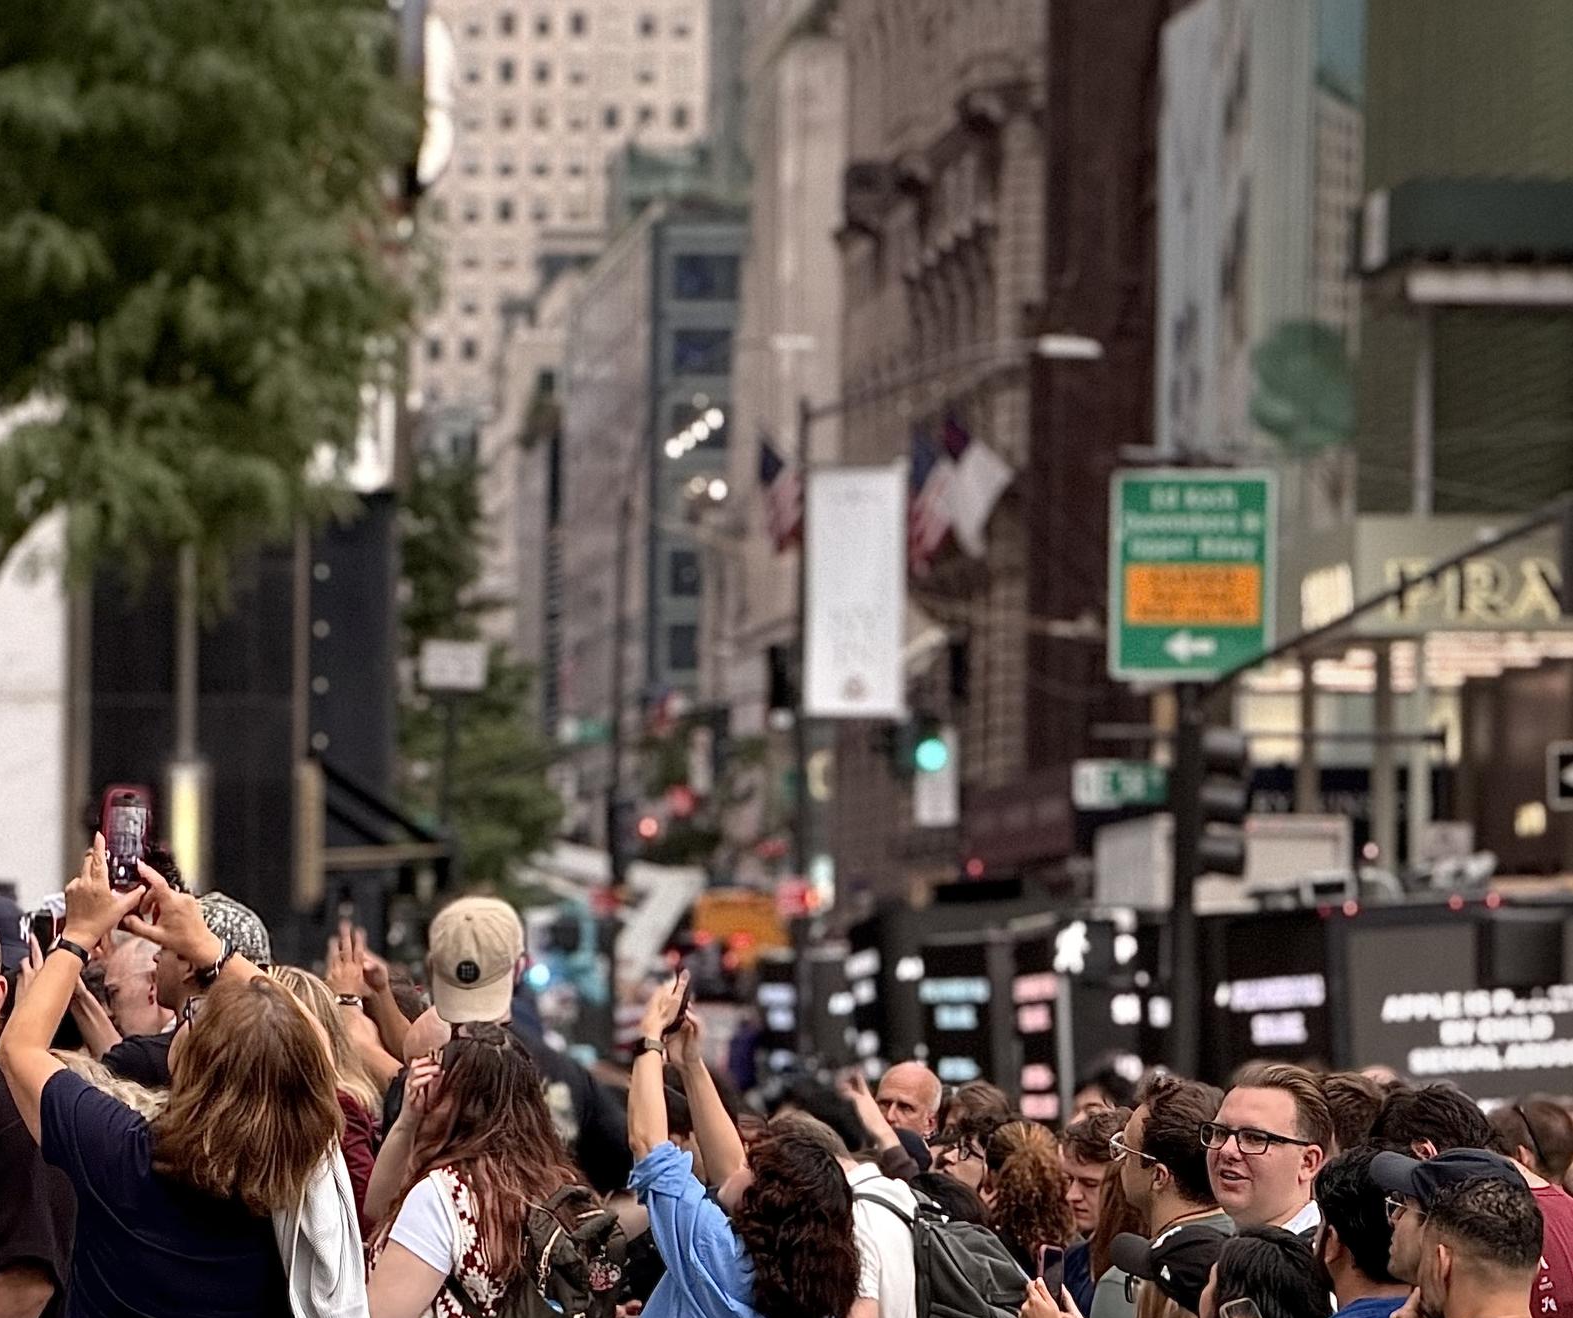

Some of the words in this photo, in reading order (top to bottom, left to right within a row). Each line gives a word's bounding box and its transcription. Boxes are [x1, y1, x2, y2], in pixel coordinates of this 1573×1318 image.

[1381, 991, 1462, 1022] APPLE
[1439, 1019, 1475, 1045] BY
[1476, 1014, 1554, 1043] CHILD
